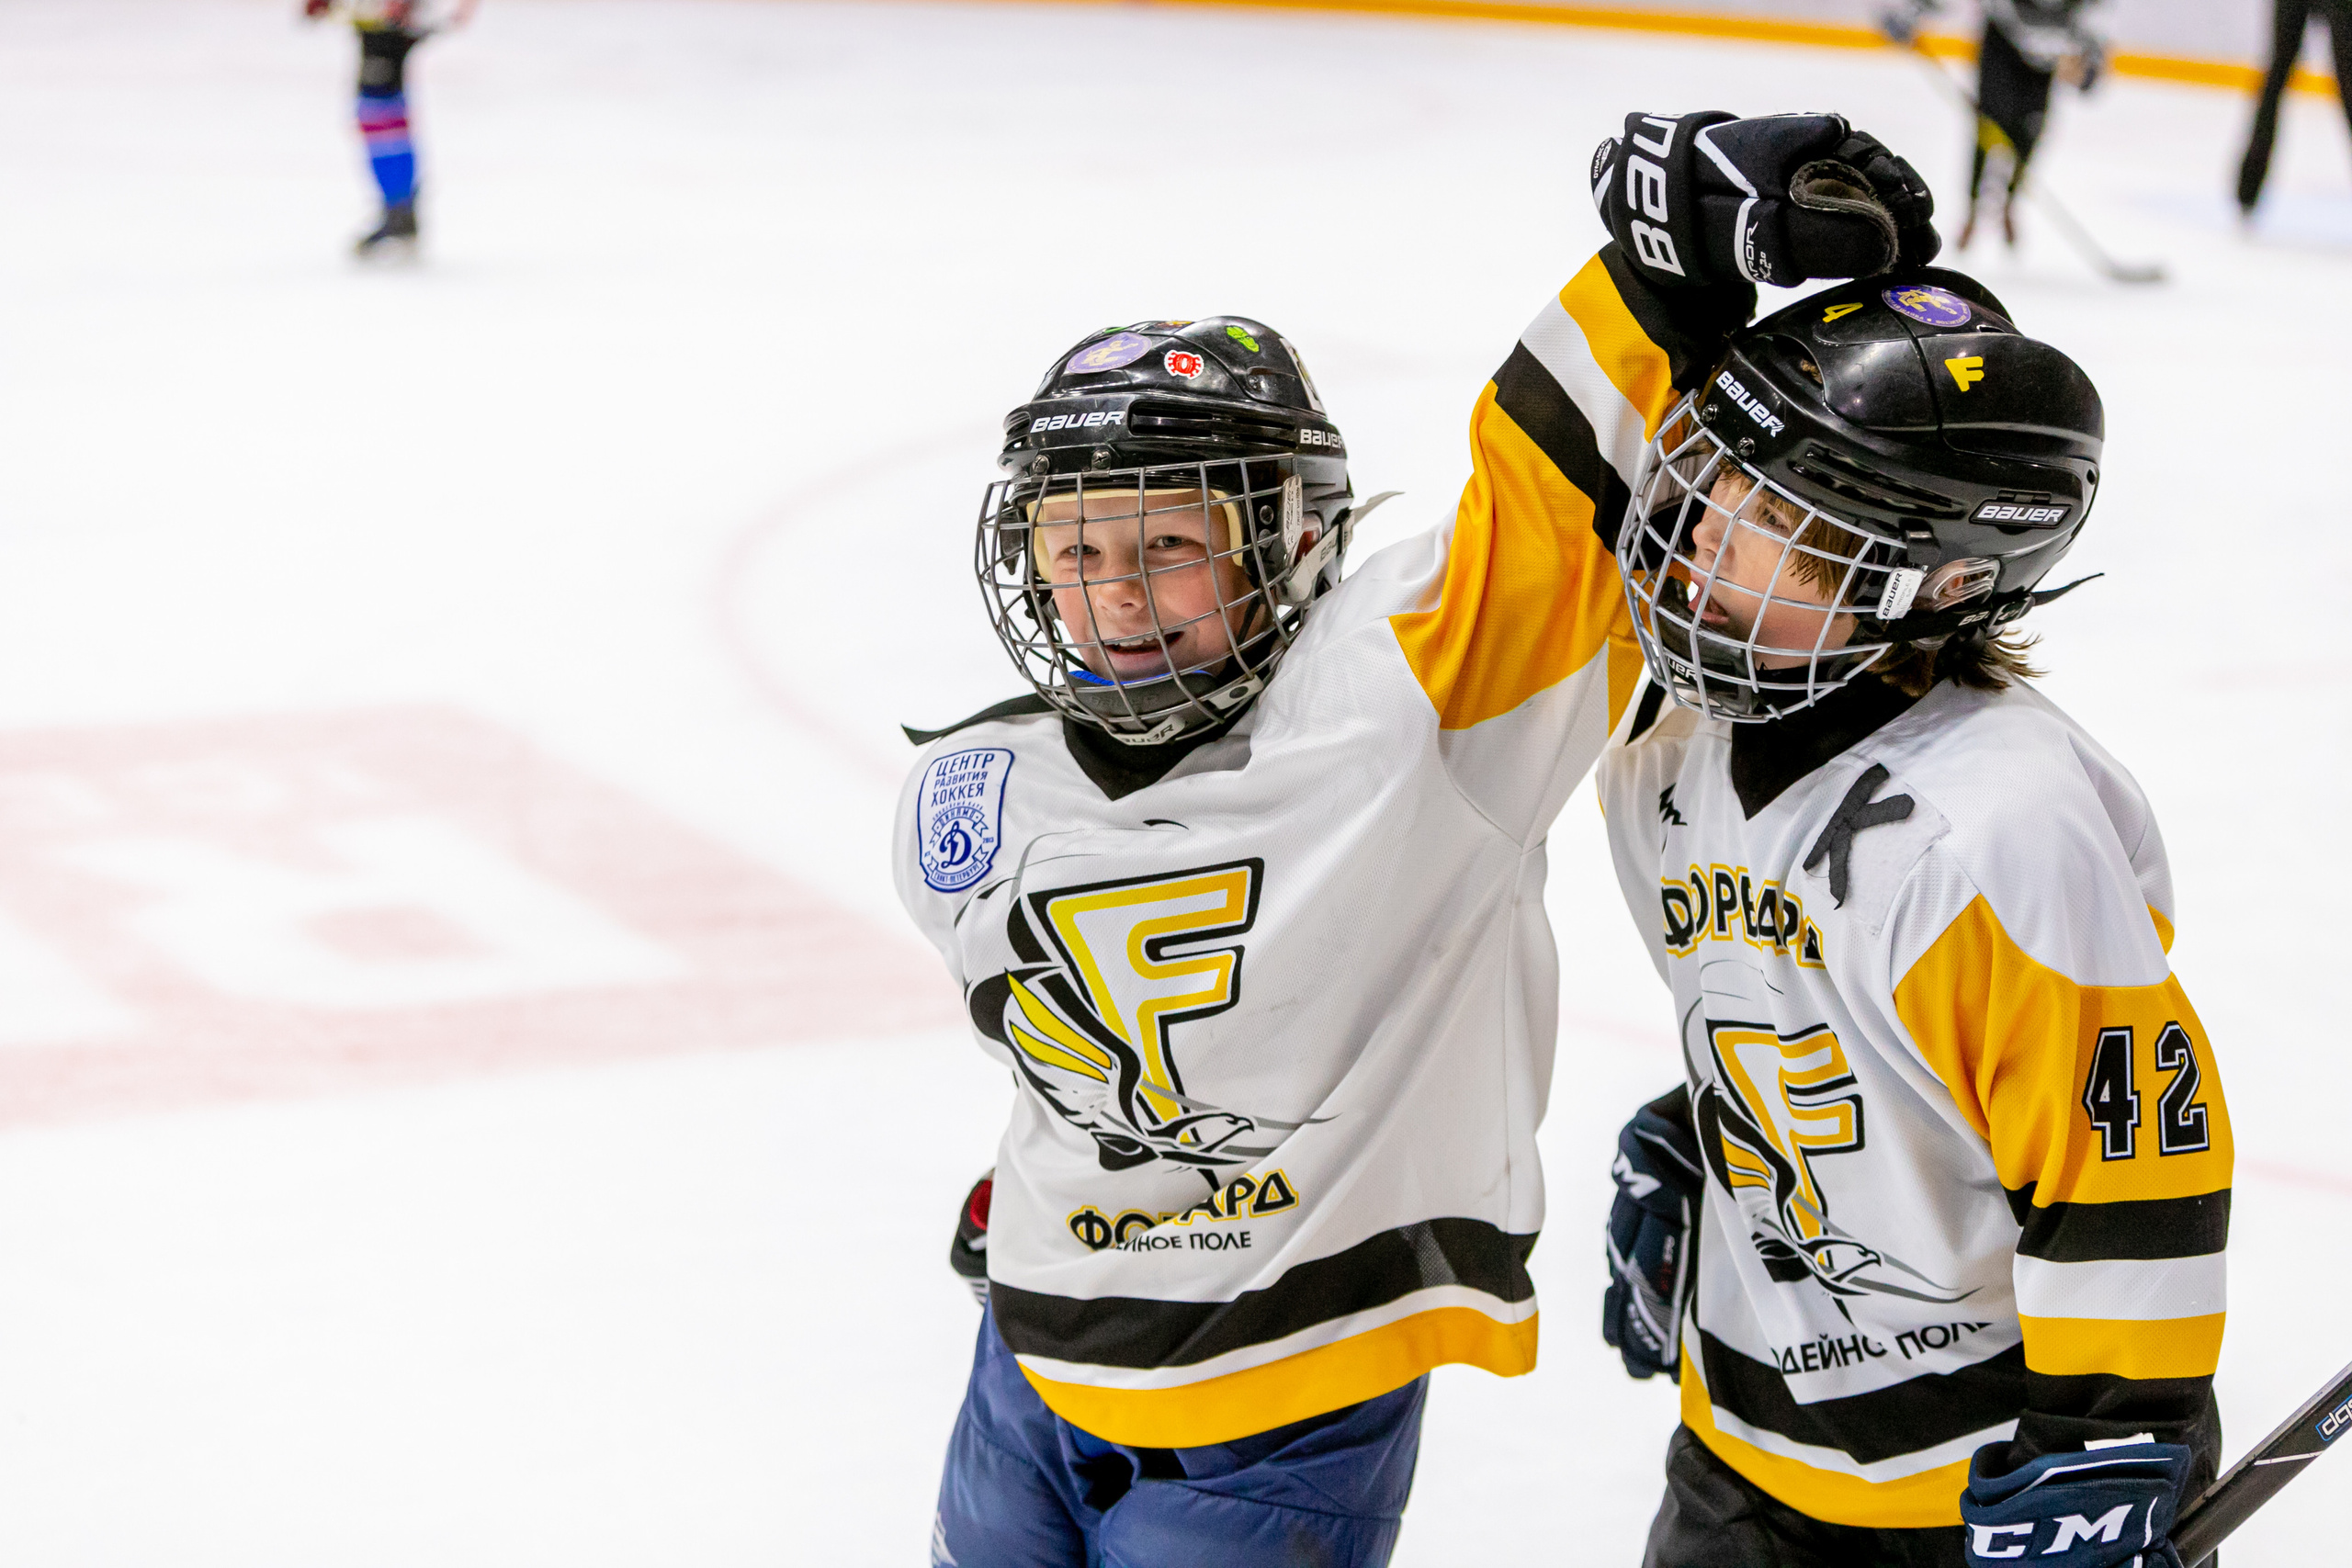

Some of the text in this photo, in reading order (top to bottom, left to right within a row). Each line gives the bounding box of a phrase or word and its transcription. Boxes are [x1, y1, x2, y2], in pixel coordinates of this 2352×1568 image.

[1626, 113, 1686, 277] BAU
[1746, 221, 1761, 281] APOR
[1944, 355, 1984, 392] F
[1715, 370, 1785, 438] BAUER
[1030, 411, 1125, 434] BAUER
[1976, 505, 2064, 523] BAUER
[1882, 572, 1903, 617] BAUER
[1668, 657, 1699, 682] UER
[934, 771, 989, 789] РАЗВИТИЯ
[935, 753, 995, 777] ЦЕНТР
[931, 782, 985, 807] ХОККЕЯ
[2081, 1021, 2211, 1162] 42
[1190, 1231, 1252, 1251] ПОЛЕ
[1895, 1323, 1994, 1360] ПОЛ
